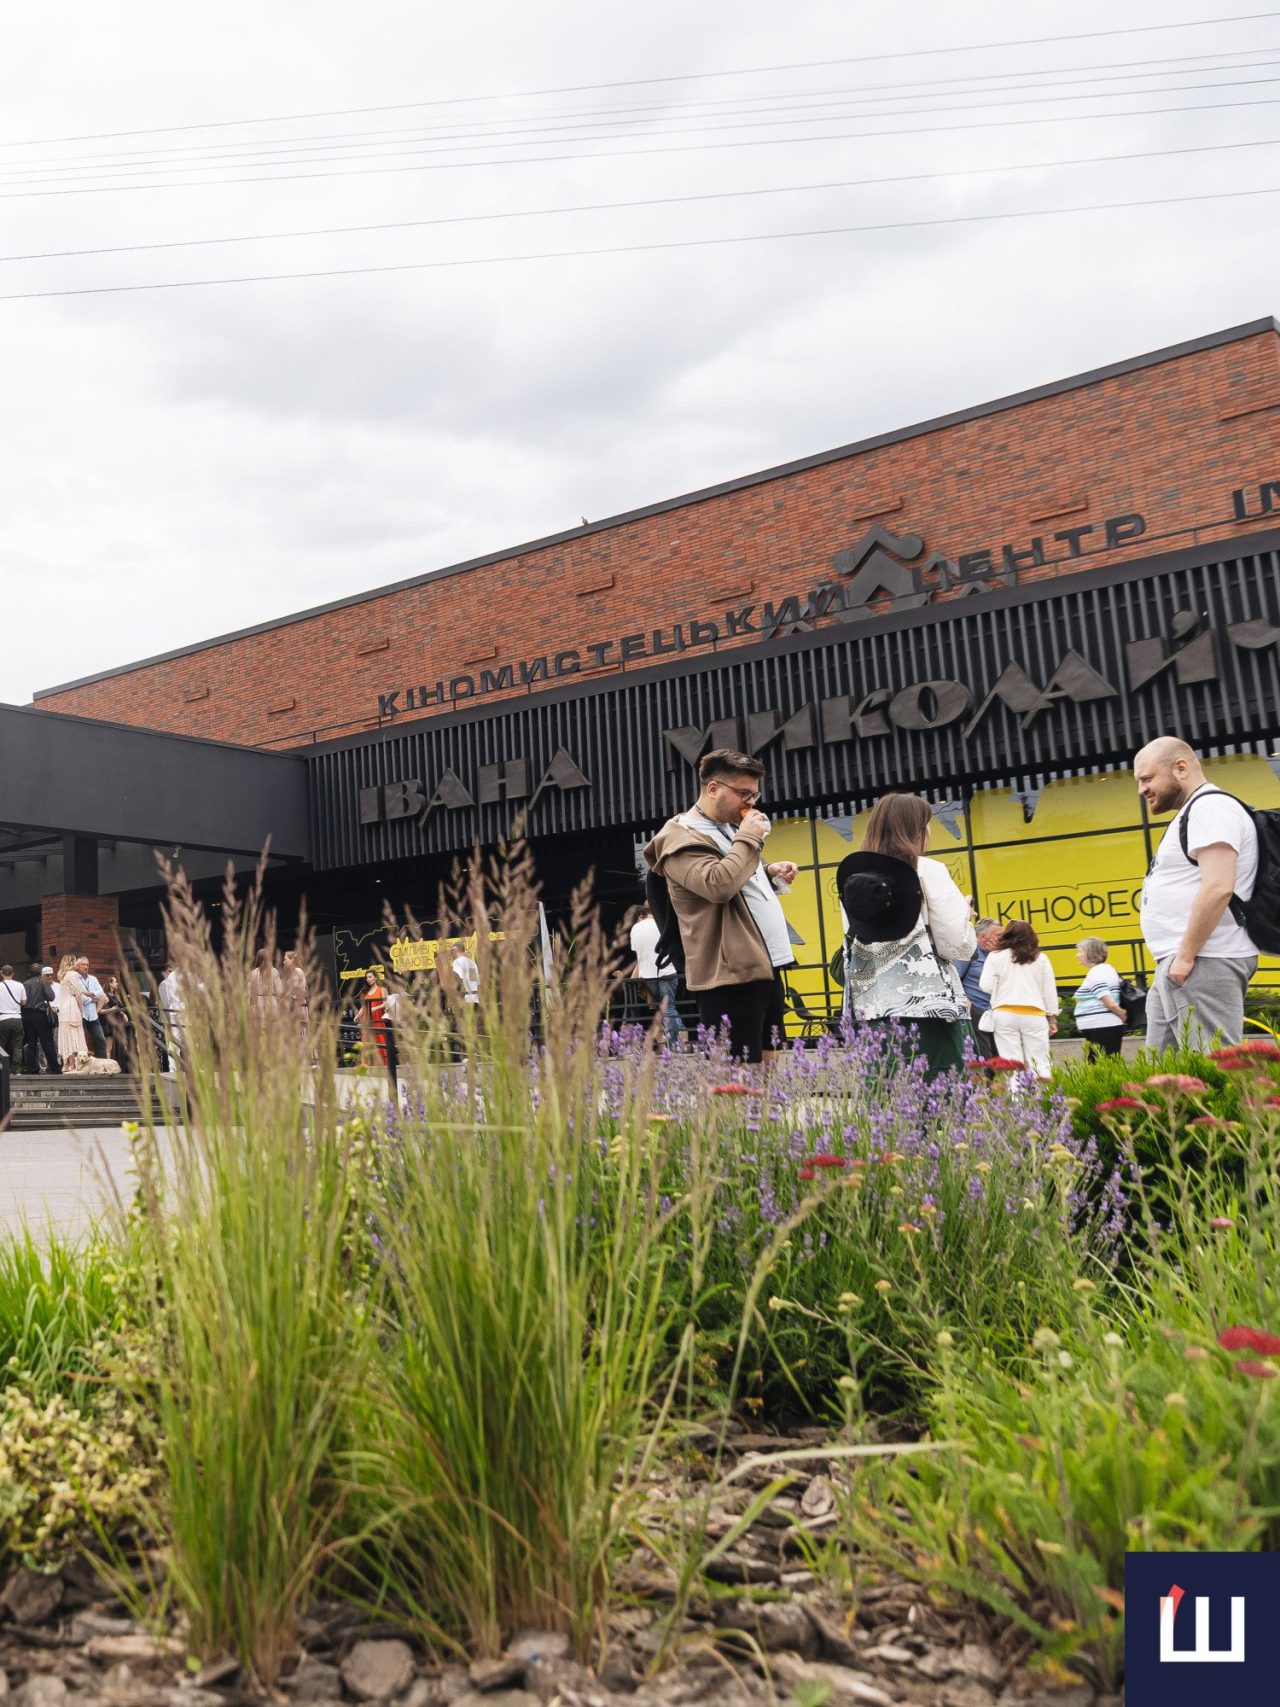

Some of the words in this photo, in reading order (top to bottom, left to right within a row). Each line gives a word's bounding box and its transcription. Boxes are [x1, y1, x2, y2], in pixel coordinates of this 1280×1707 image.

[378, 577, 847, 717] КІНОМИСТЕЦЬКИЙ
[911, 512, 1147, 591] ЦЕНТР
[360, 745, 591, 827] ІВАНА
